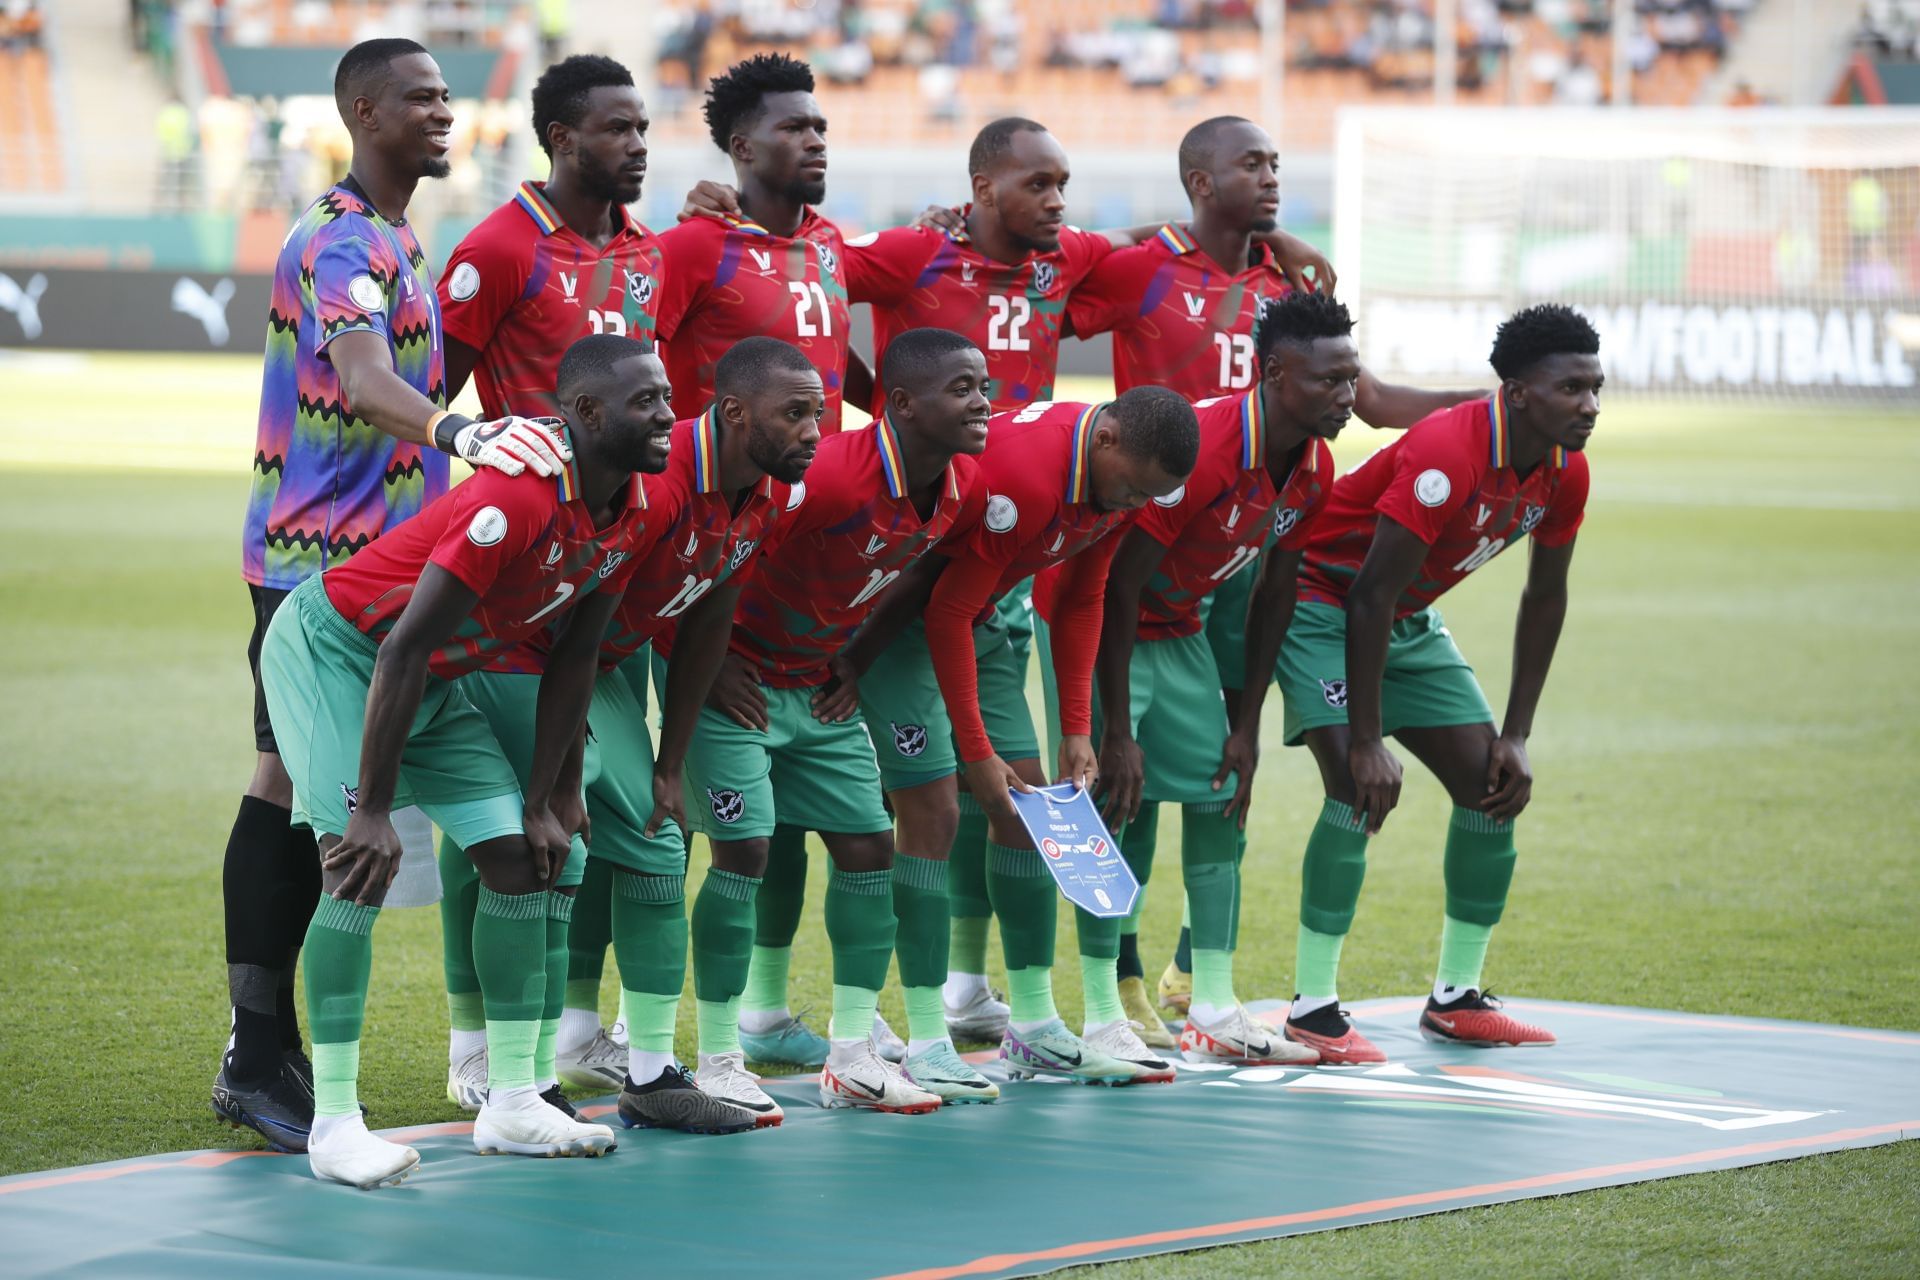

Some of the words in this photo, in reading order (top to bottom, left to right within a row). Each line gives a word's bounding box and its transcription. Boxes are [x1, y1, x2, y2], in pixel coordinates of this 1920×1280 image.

[788, 281, 831, 337] 21
[988, 294, 1031, 351] 22
[1214, 331, 1255, 389] 13
[1209, 545, 1260, 580] 11
[1452, 536, 1505, 571] 18
[523, 582, 575, 624] 7
[655, 574, 713, 617] 19
[847, 568, 900, 608] 10
